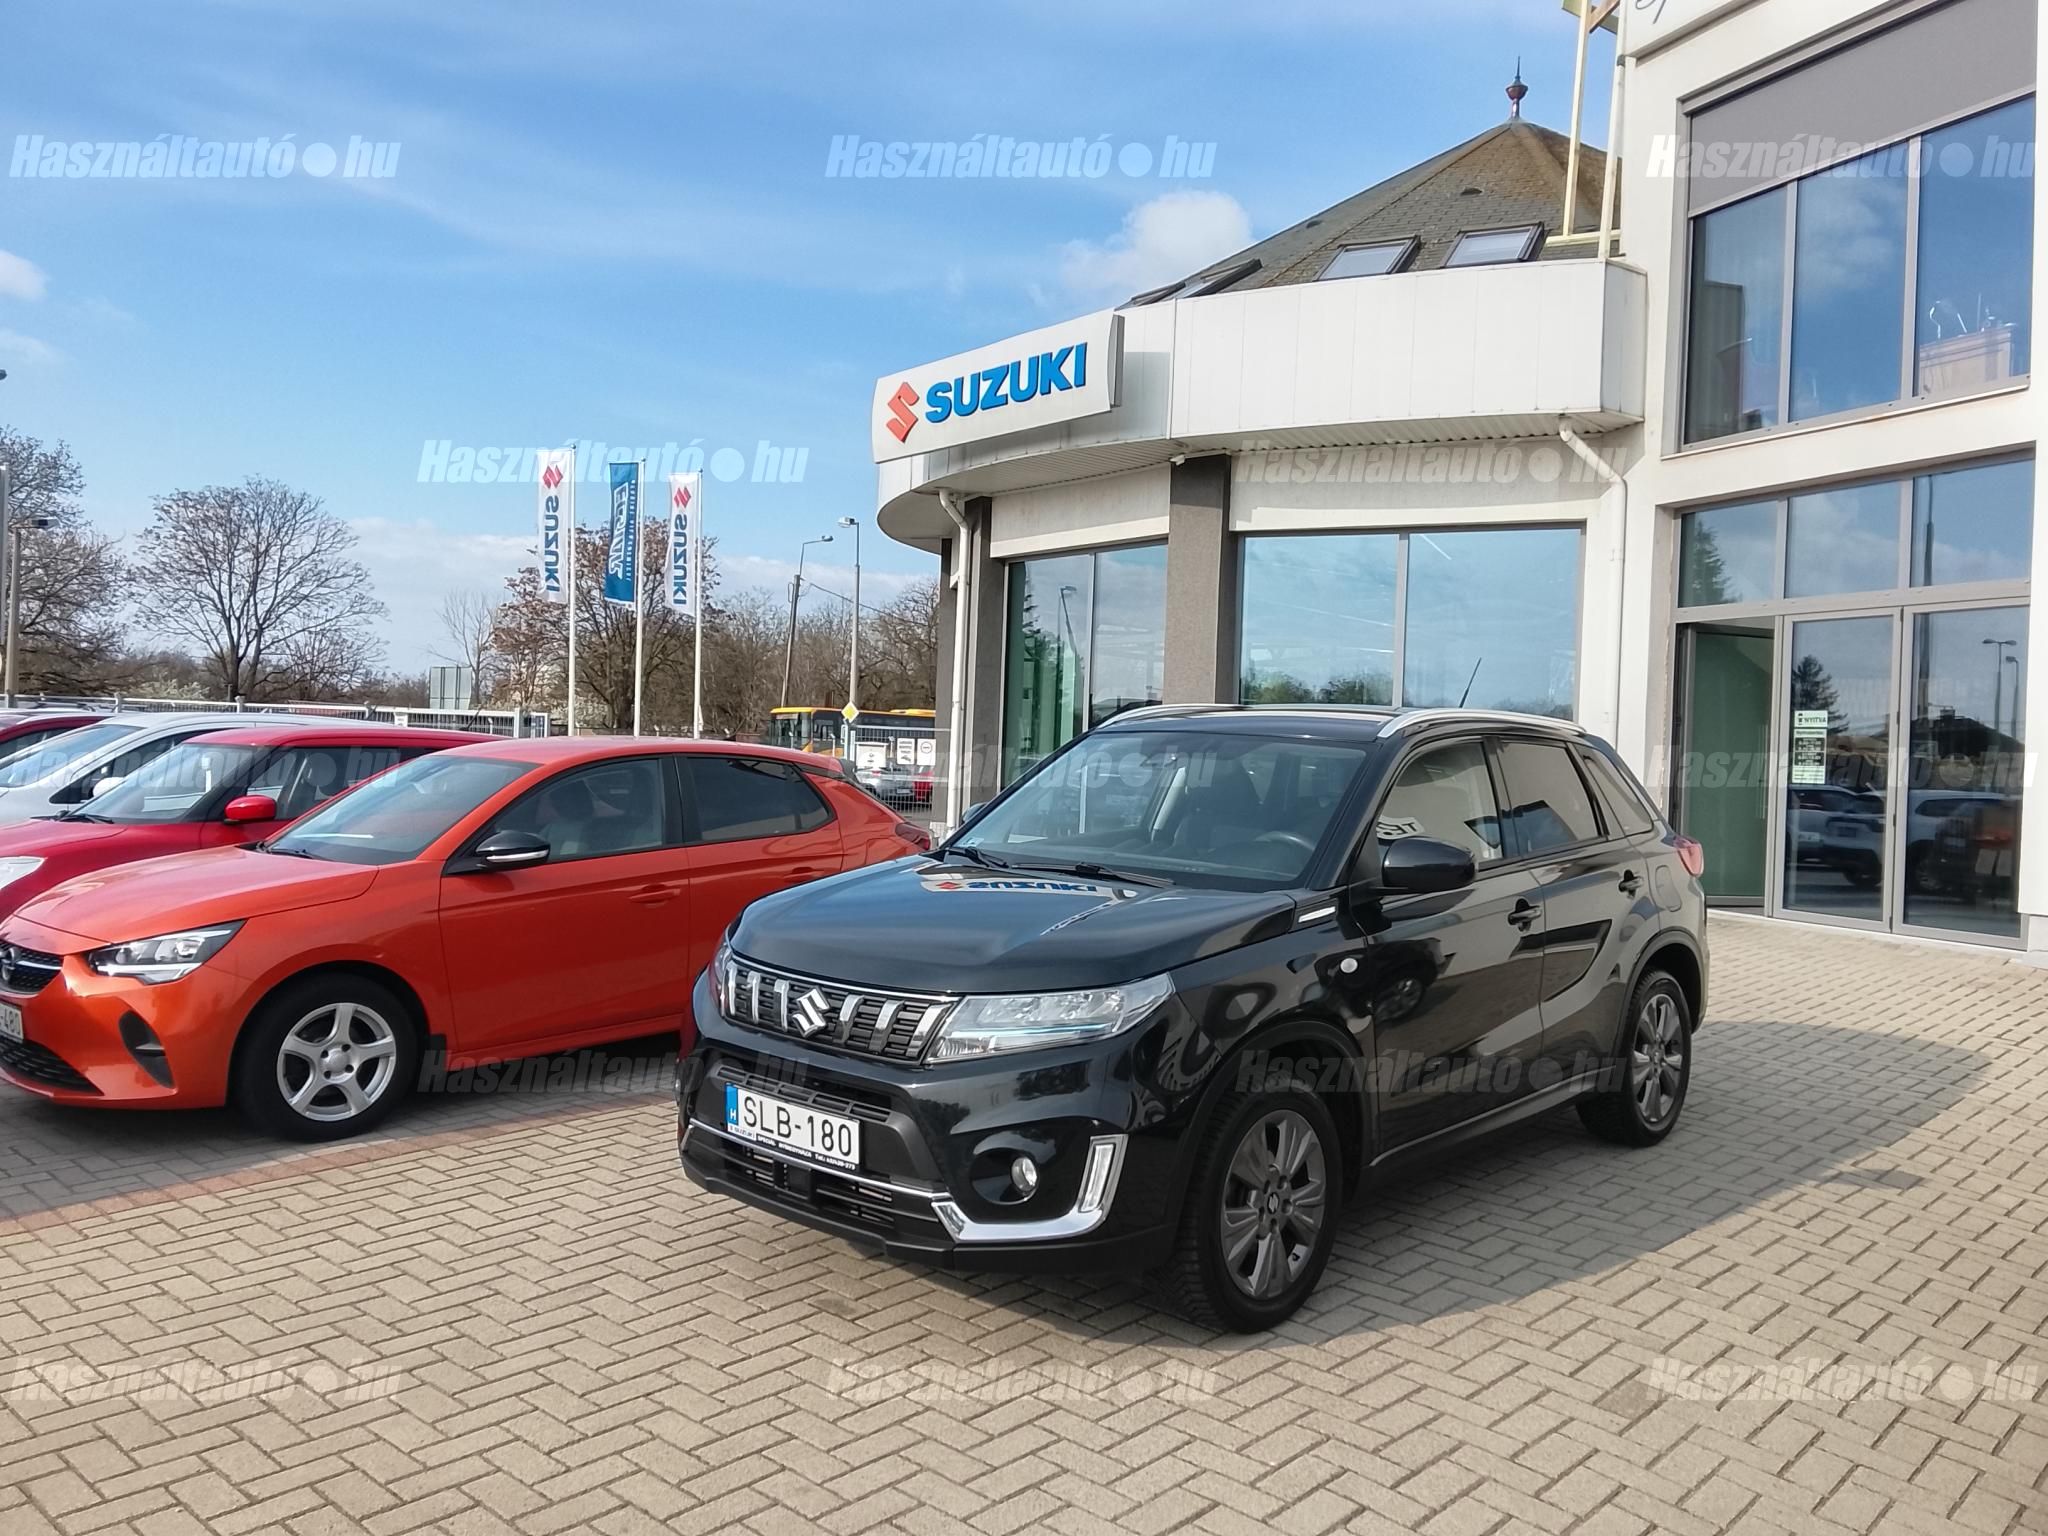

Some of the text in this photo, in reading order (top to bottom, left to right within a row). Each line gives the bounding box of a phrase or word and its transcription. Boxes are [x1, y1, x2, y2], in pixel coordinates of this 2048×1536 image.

[925, 342, 1088, 424] SUZUKI
[729, 1109, 737, 1120] H
[743, 1096, 851, 1157] SLB-180
